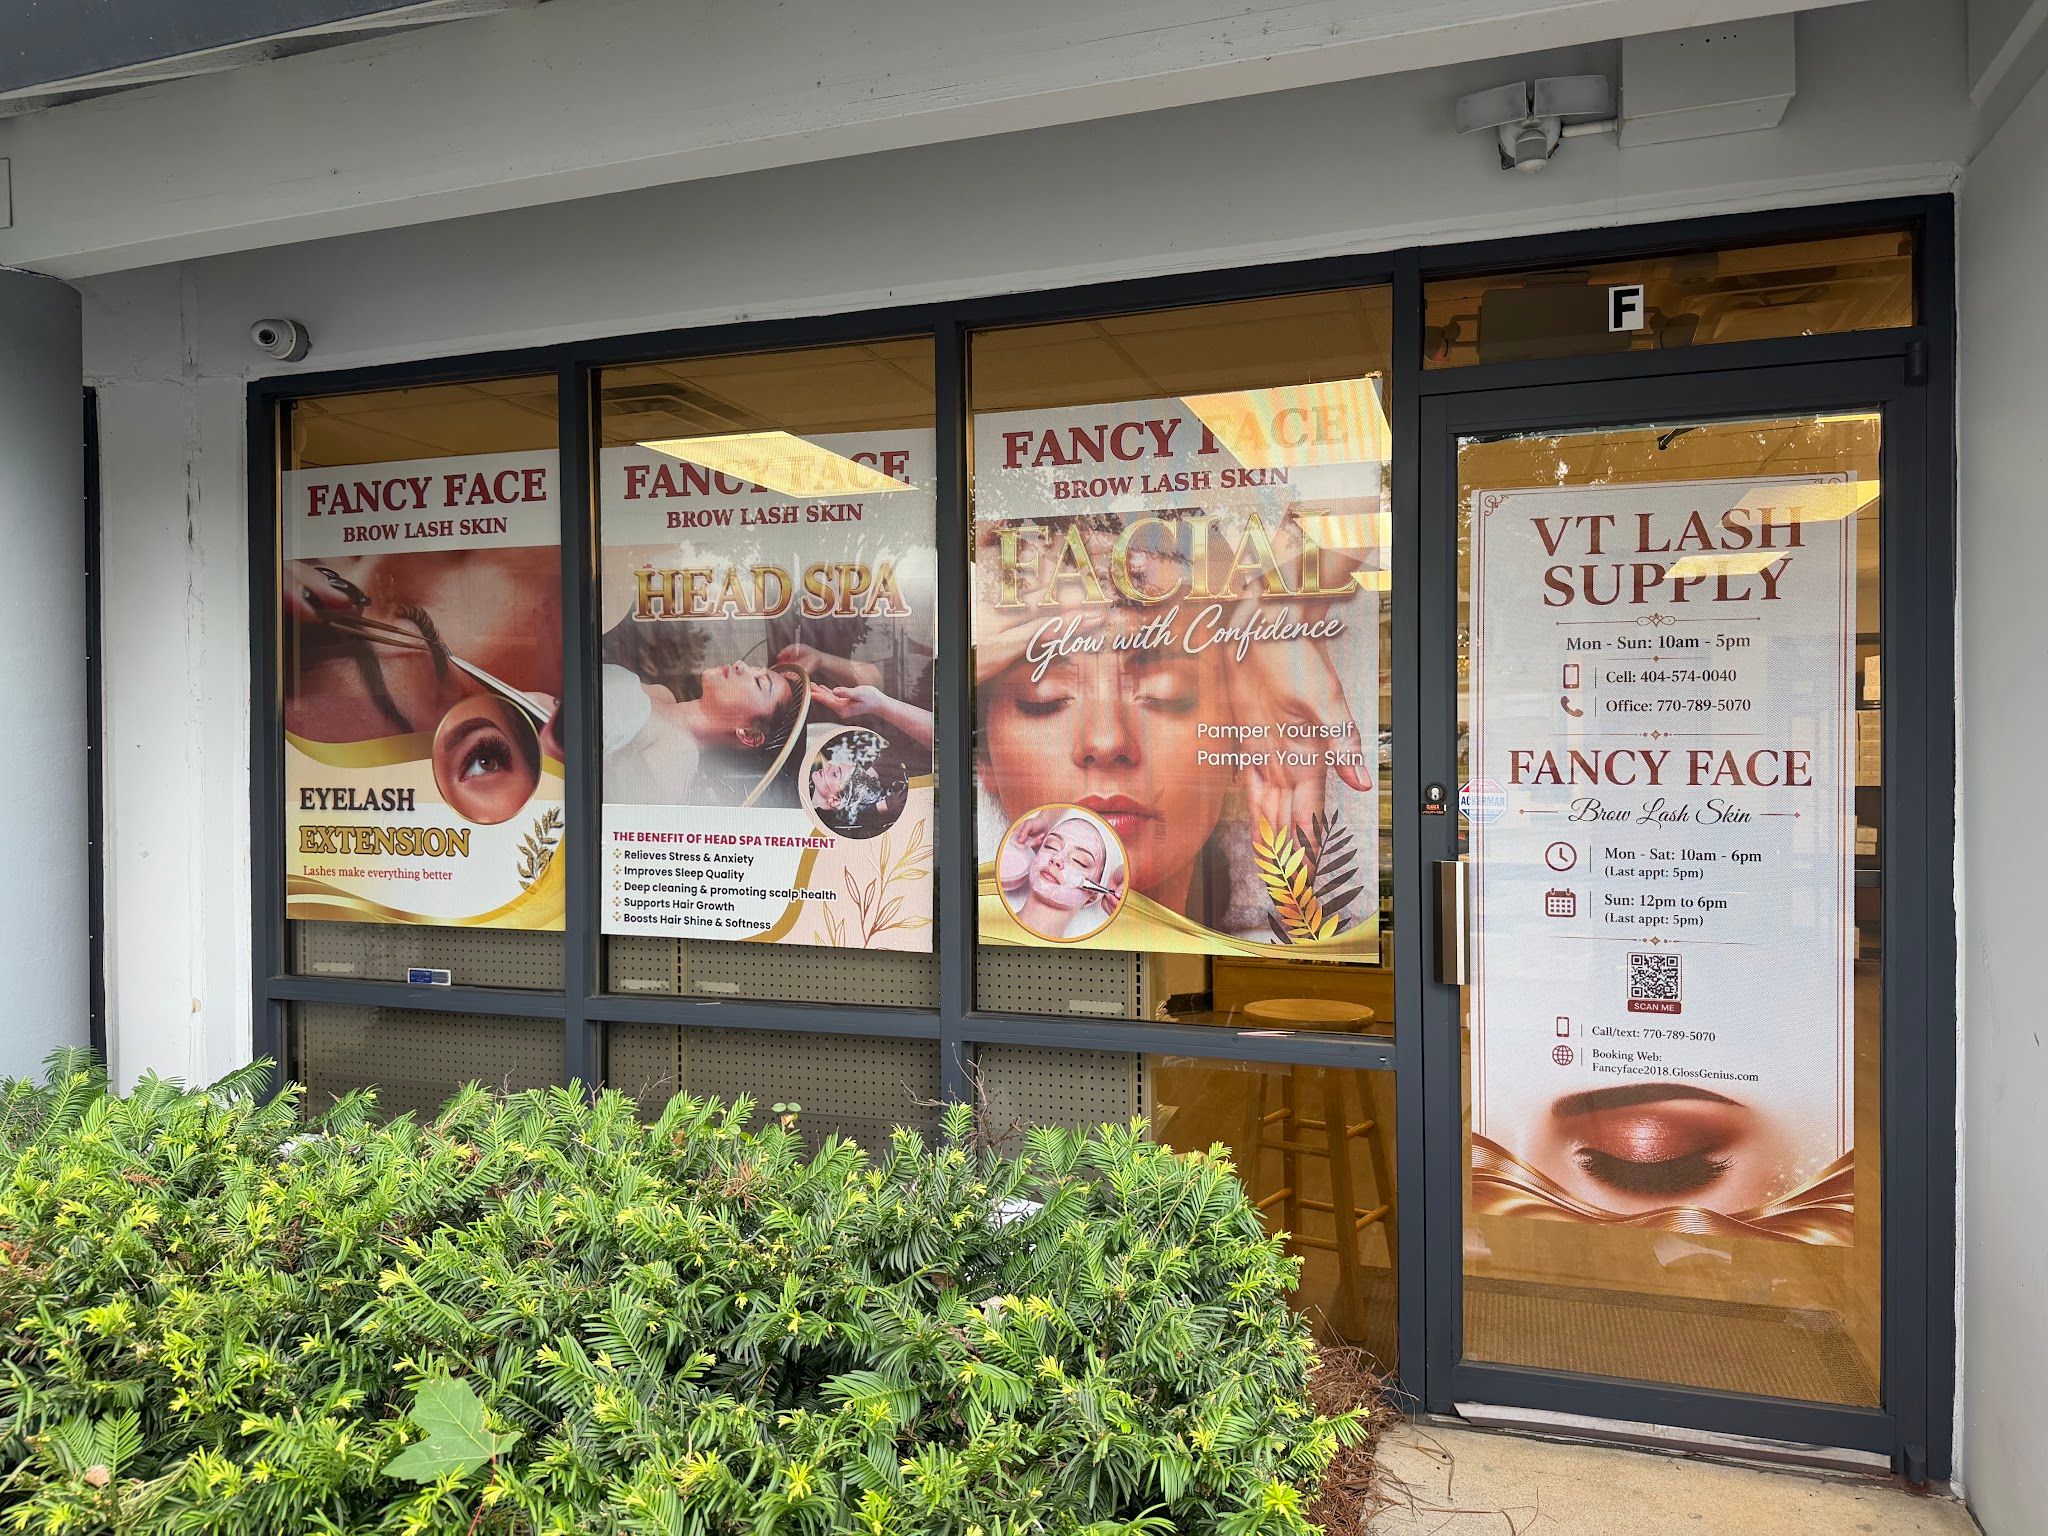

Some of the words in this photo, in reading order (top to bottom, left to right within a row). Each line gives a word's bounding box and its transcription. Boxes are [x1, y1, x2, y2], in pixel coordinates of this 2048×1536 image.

[1614, 288, 1639, 328] F
[1003, 419, 1182, 469] FANCY
[1197, 404, 1349, 454] FACE
[307, 477, 432, 516] FANCY
[444, 469, 546, 506] FACE
[1054, 477, 1133, 500] BROW
[1141, 471, 1210, 493] LASH
[1221, 466, 1289, 488] SKIN
[667, 509, 734, 528] BROW
[741, 506, 798, 525] LASH
[806, 504, 863, 522] SKIN
[344, 524, 399, 542] BROW
[405, 520, 453, 538] LASH
[460, 518, 507, 535] SKIN
[1530, 515, 1616, 556] VT
[1635, 506, 1806, 553] LASH
[994, 508, 1359, 609] FACIAL
[632, 564, 793, 620] HEAD
[801, 562, 911, 617] SPA
[1543, 558, 1793, 607] SUPPLY
[1026, 616, 1104, 683] Glow
[1113, 606, 1177, 650] with
[1183, 604, 1344, 662] Confidence
[1567, 637, 1601, 650] Mon
[1618, 636, 1652, 649] Sun:
[1658, 635, 1699, 649] 10am
[1716, 635, 1750, 651] 5pm
[1606, 670, 1636, 683] Cell:
[1640, 669, 1737, 682] 404-574-0040
[1606, 700, 1652, 712] Office:
[1657, 699, 1751, 712] 770-789-5070
[1197, 723, 1270, 742] Pamper
[1276, 722, 1354, 738] Yourself
[1197, 751, 1270, 769] Pamper
[1276, 751, 1318, 766] Your
[1325, 751, 1363, 766] Skin
[1508, 749, 1670, 785] FANCY
[1687, 749, 1812, 787] FACE
[300, 788, 415, 811] EYELASH
[1569, 798, 1631, 822] Brow
[1636, 798, 1690, 830] Lash
[1695, 799, 1751, 825] Skin
[299, 826, 470, 857] EXTENSION
[613, 832, 635, 841] THE
[637, 833, 684, 843] BENEFIT
[687, 834, 702, 843] OF
[705, 835, 737, 845] HEAD
[739, 836, 761, 846] SPA
[765, 837, 835, 848] TREATMENT
[624, 851, 667, 860] Relieves
[669, 852, 701, 862] Stress
[703, 853, 711, 862] &
[714, 854, 754, 865] Anxiety
[1604, 848, 1636, 861] Mon
[1650, 848, 1675, 861] Sat:
[1680, 849, 1716, 862] 10am
[1731, 849, 1762, 866] 6pm
[304, 866, 336, 877] Lashes
[339, 867, 365, 877] make
[368, 868, 420, 880] everything
[423, 869, 452, 880] better
[624, 867, 672, 878] Improves
[675, 868, 703, 878] Sleep
[706, 870, 744, 881] Quality
[1604, 865, 1635, 878] (Last
[1638, 867, 1669, 880] appt:
[1673, 867, 1704, 880] 5pm)
[624, 882, 650, 892] Deep
[652, 883, 697, 896] cleaning
[700, 885, 707, 894] &
[710, 886, 766, 899] promoting
[769, 889, 798, 901] scalp
[801, 890, 836, 900] health
[624, 898, 670, 909] Supports
[673, 899, 694, 909] Hair
[696, 901, 734, 911] Growth
[1604, 894, 1635, 906] Sun:
[1640, 895, 1676, 909] 12pm
[1681, 896, 1694, 908] to
[1698, 896, 1727, 911] 6pm
[624, 914, 658, 924] Boosts
[660, 915, 681, 925] Hair
[684, 916, 713, 926] Shine
[715, 918, 723, 927] &
[725, 919, 771, 929] Softness
[1604, 912, 1635, 924] (Last
[1638, 913, 1669, 926] appt:
[1673, 913, 1704, 927] 5pm)
[1592, 1026, 1639, 1038] Call/text:
[1643, 1029, 1715, 1041] 770-789-5070
[1593, 1049, 1633, 1061] Booking
[1637, 1052, 1662, 1062] Web:
[1593, 1063, 1758, 1082] Fancyface2018.GlossGenius.com
